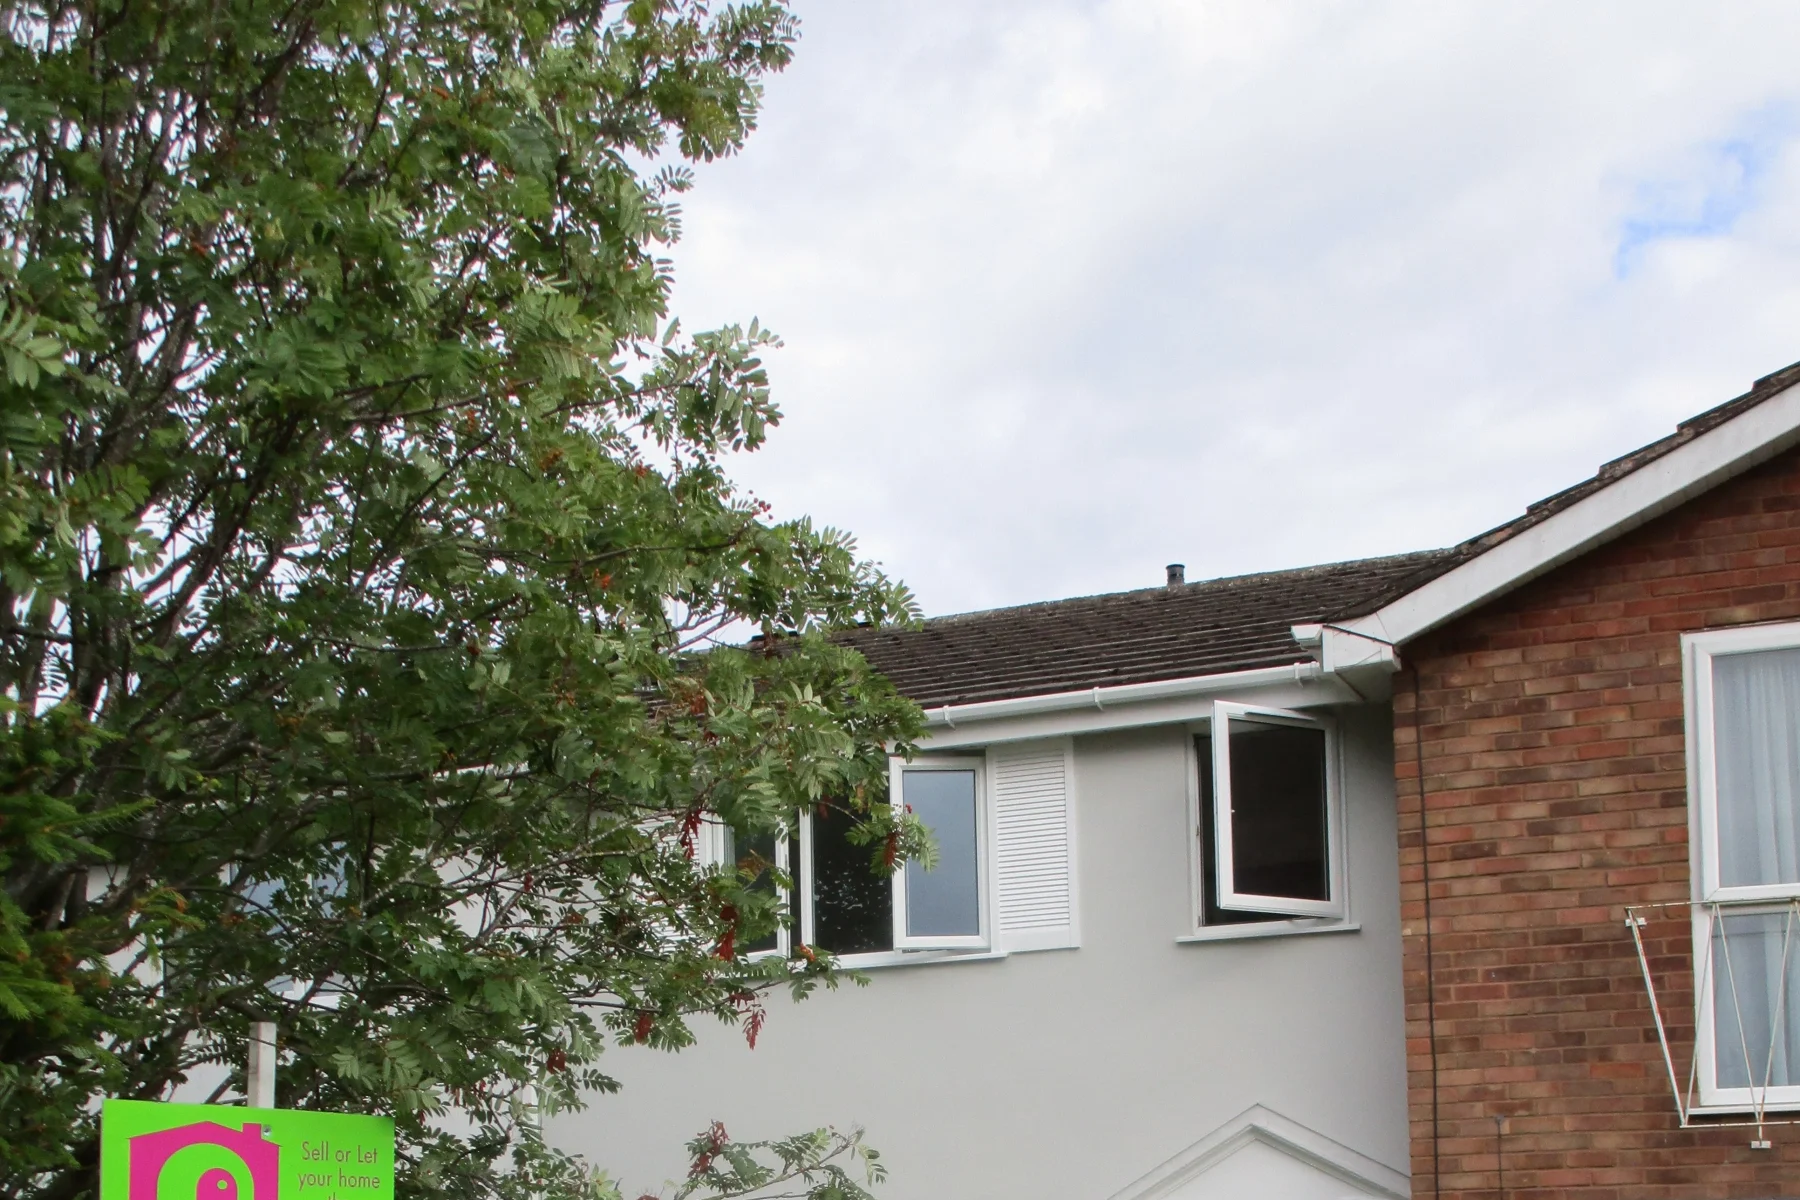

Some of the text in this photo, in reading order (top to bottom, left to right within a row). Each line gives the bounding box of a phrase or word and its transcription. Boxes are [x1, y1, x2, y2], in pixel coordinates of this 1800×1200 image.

[301, 1141, 378, 1164] Sell or Let
[297, 1168, 381, 1190] your home
